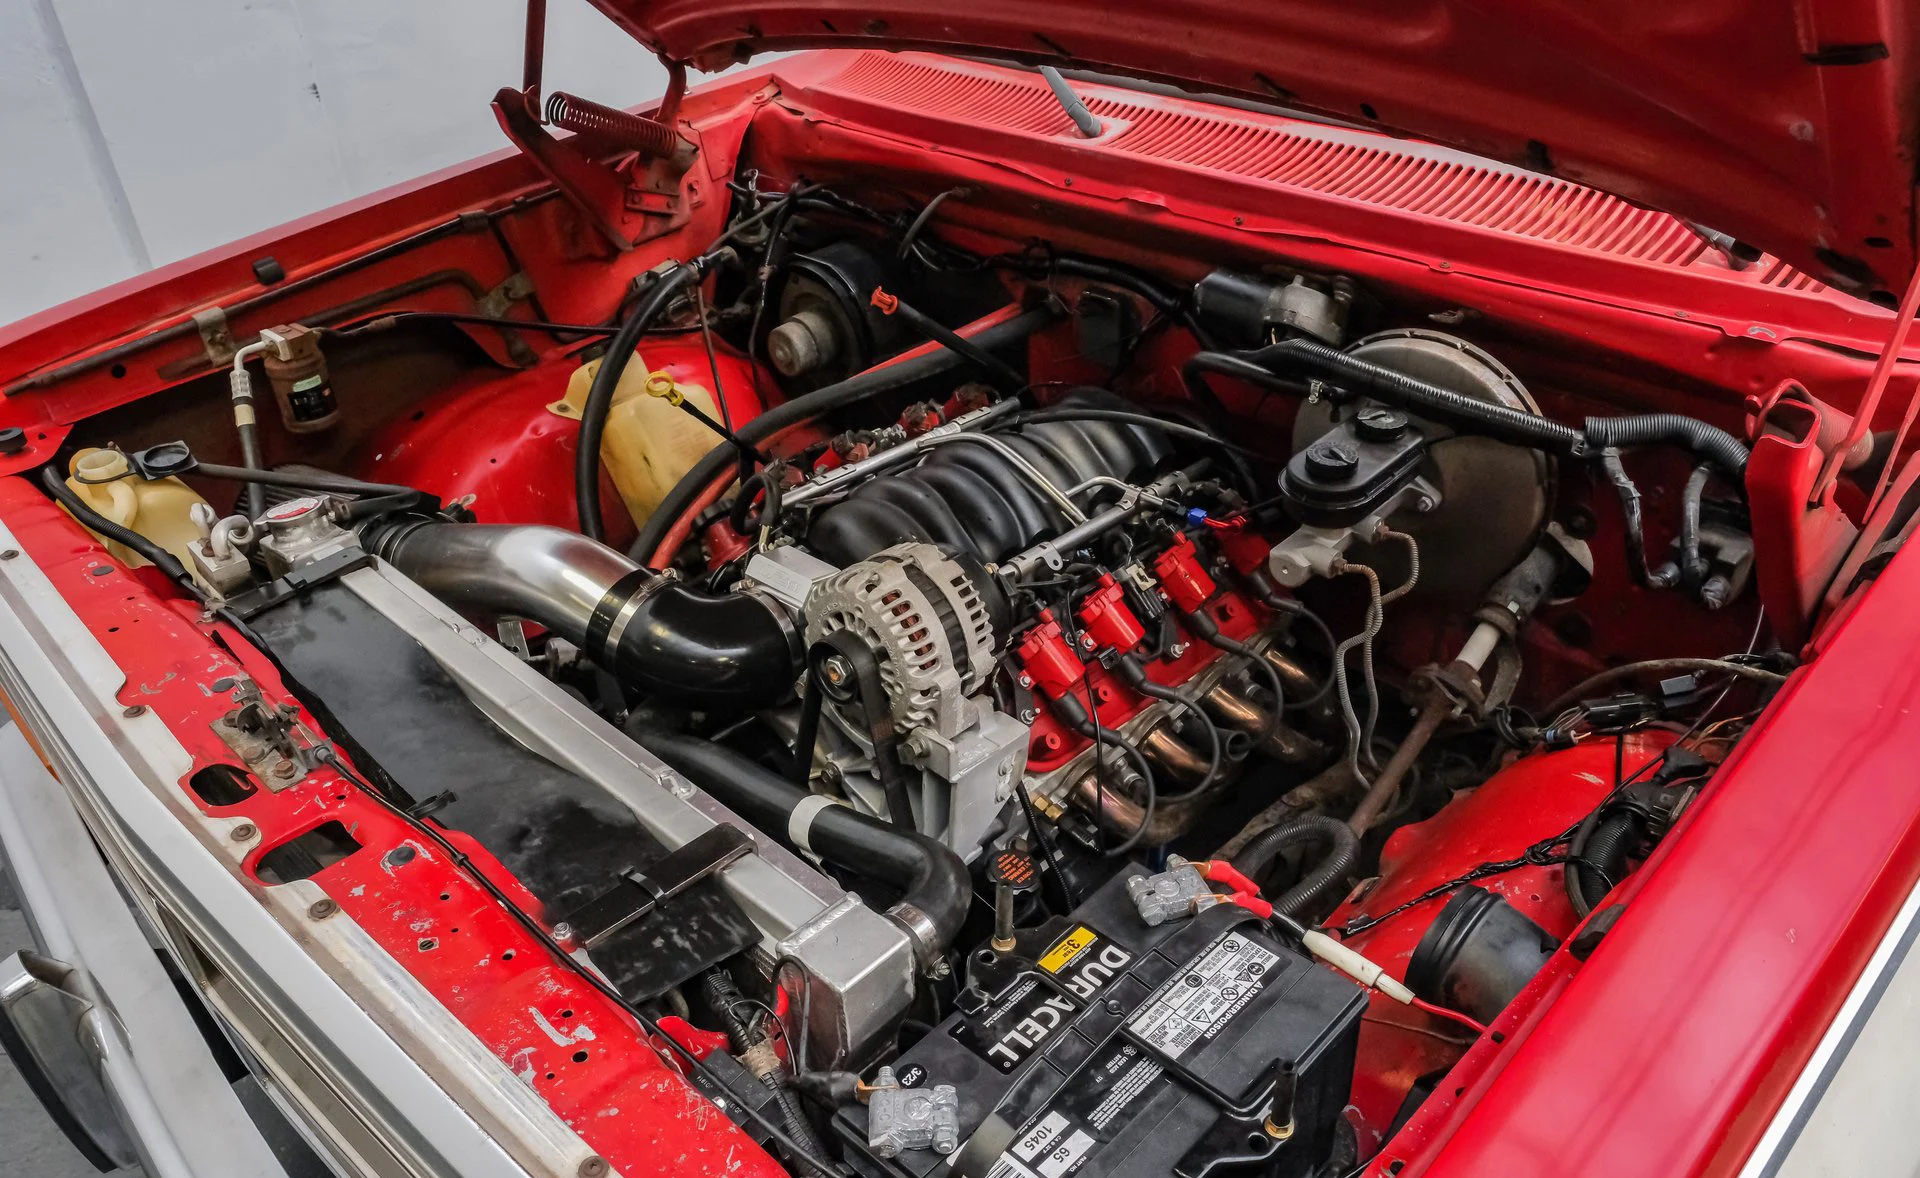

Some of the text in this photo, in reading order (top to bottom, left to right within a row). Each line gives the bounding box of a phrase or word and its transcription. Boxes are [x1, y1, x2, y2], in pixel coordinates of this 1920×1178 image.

[1065, 937, 1081, 951] 3
[986, 943, 1130, 1061] DURACELL
[1202, 986, 1259, 1039] DANGER/POISON
[1104, 1053, 1123, 1069] BATTERY
[1107, 1055, 1130, 1074] LEAD ACID
[900, 1066, 922, 1086] 3/23
[1022, 1123, 1054, 1151] 1045
[1053, 1134, 1062, 1142] CA
[1051, 1145, 1072, 1163] 65
[1067, 1155, 1087, 1173] PART NO.
